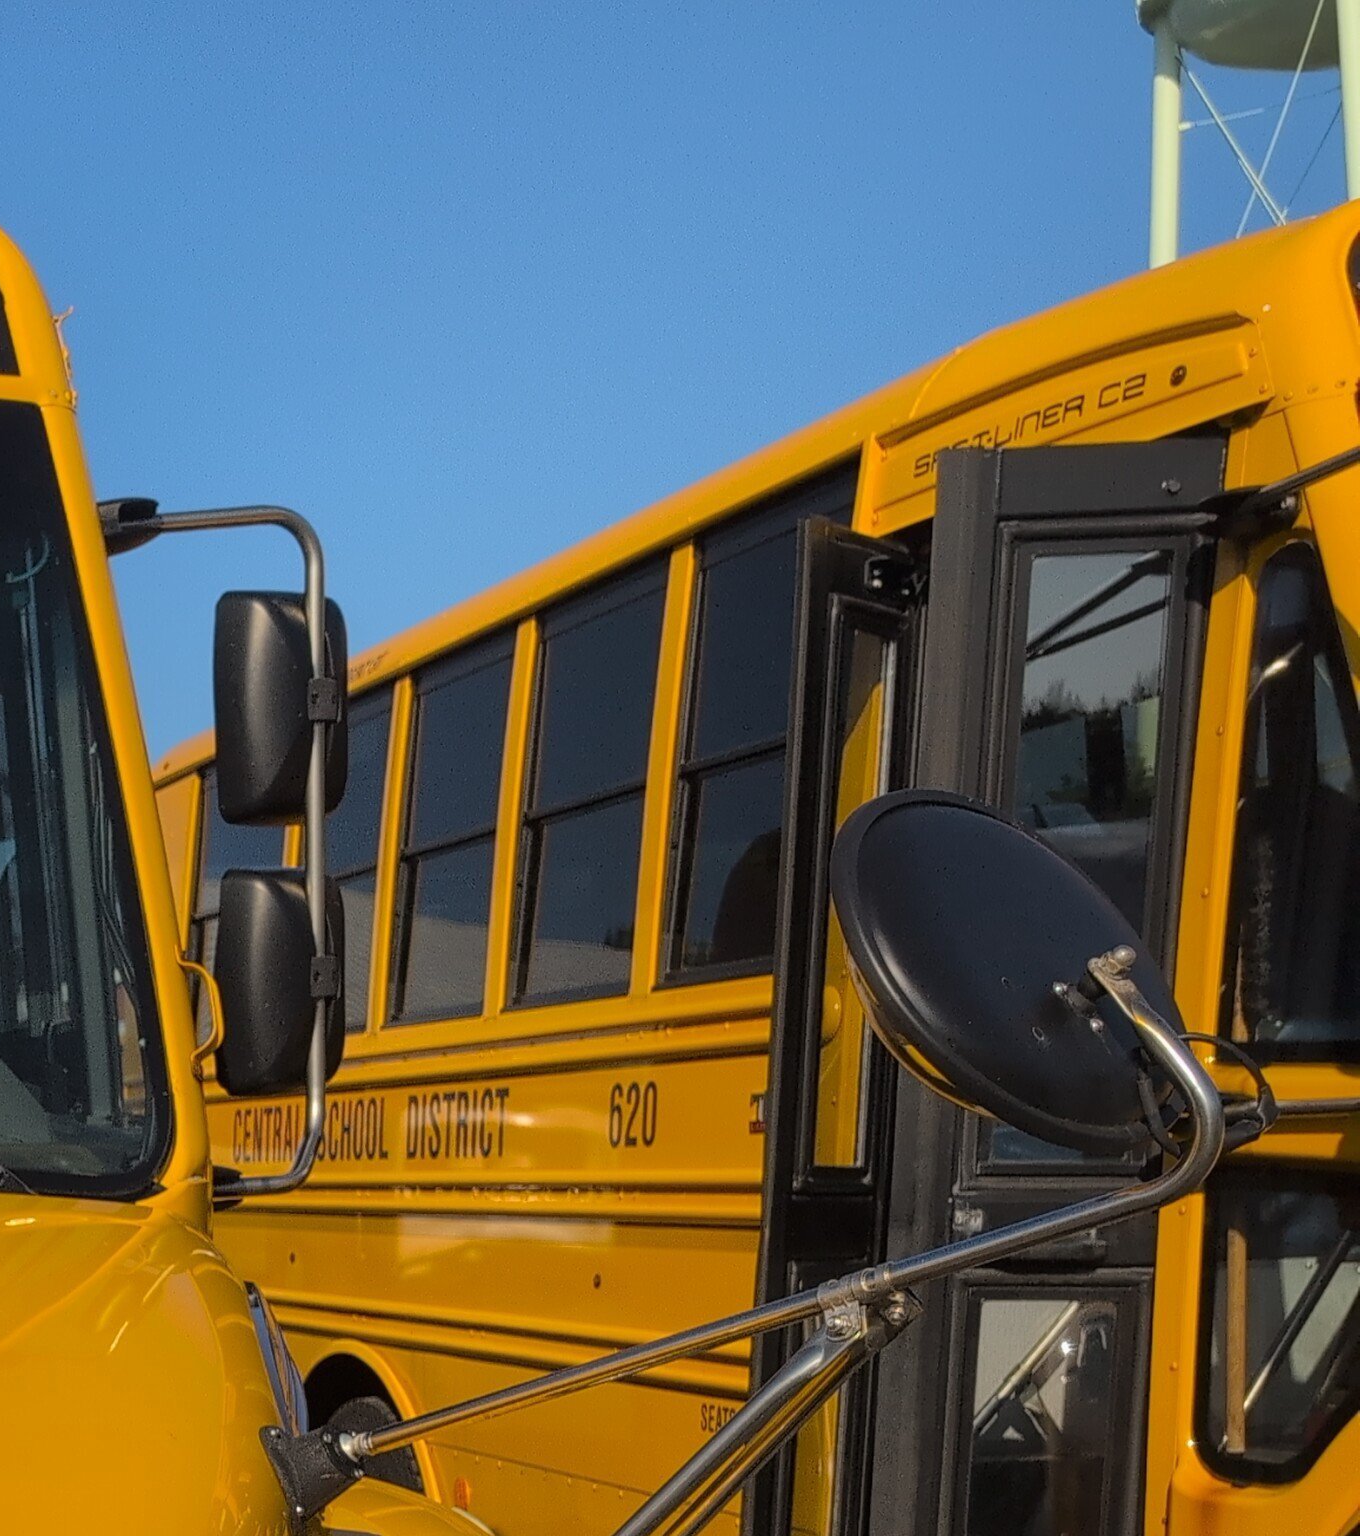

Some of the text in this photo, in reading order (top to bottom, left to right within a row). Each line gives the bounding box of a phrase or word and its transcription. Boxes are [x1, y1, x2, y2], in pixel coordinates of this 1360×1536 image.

[1098, 373, 1147, 409] C2
[406, 1087, 511, 1161] DISTRICT
[608, 1081, 658, 1149] 620
